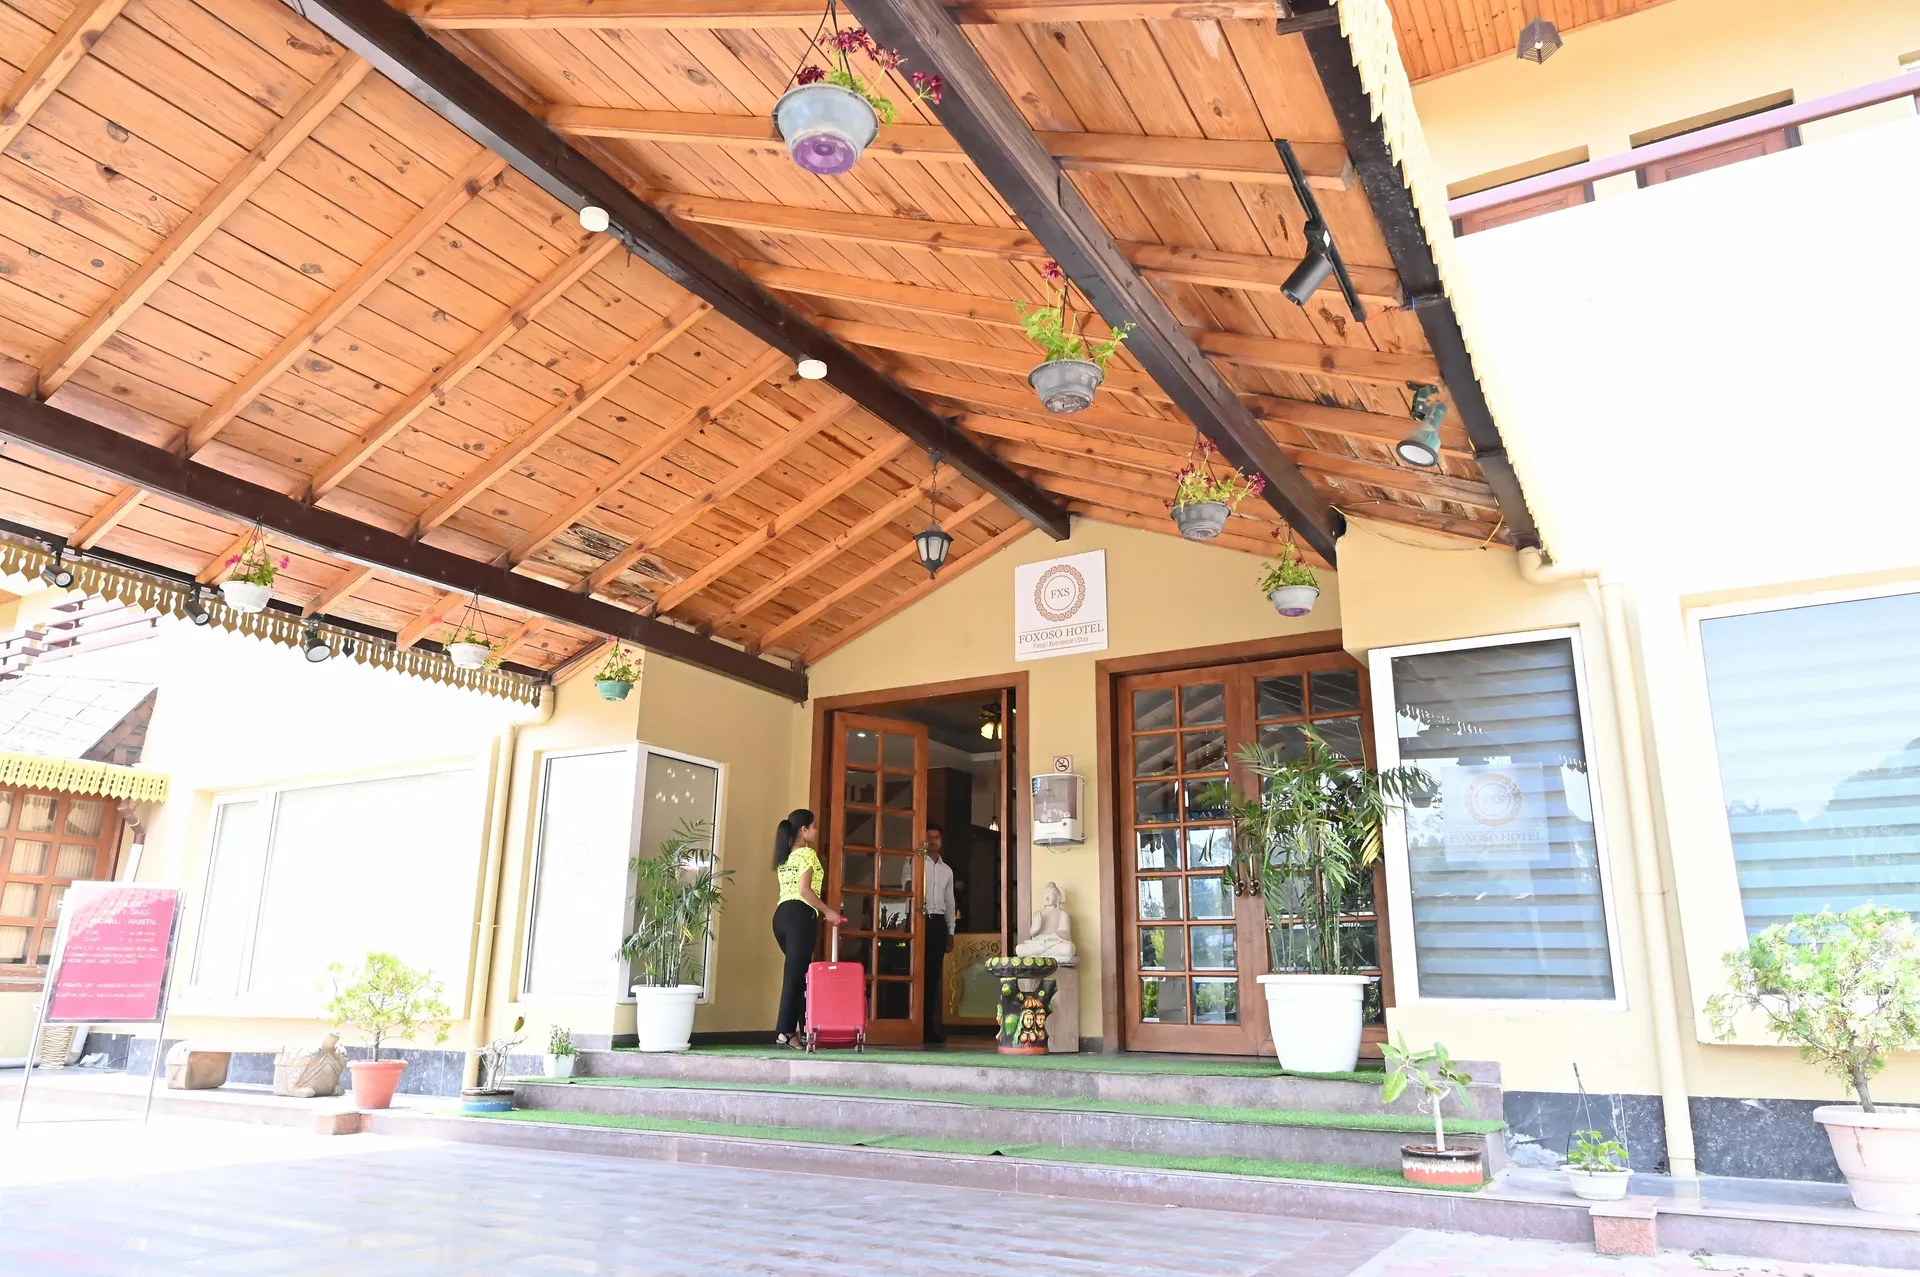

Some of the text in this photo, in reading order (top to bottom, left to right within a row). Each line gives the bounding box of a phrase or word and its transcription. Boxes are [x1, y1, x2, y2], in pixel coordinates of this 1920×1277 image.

[1051, 587, 1070, 599] FXS
[1019, 623, 1104, 644] FOXOSO HOTEL
[1033, 641, 1045, 649] Food
[1048, 638, 1073, 647] Xperience
[1502, 832, 1544, 841] HOTEL
